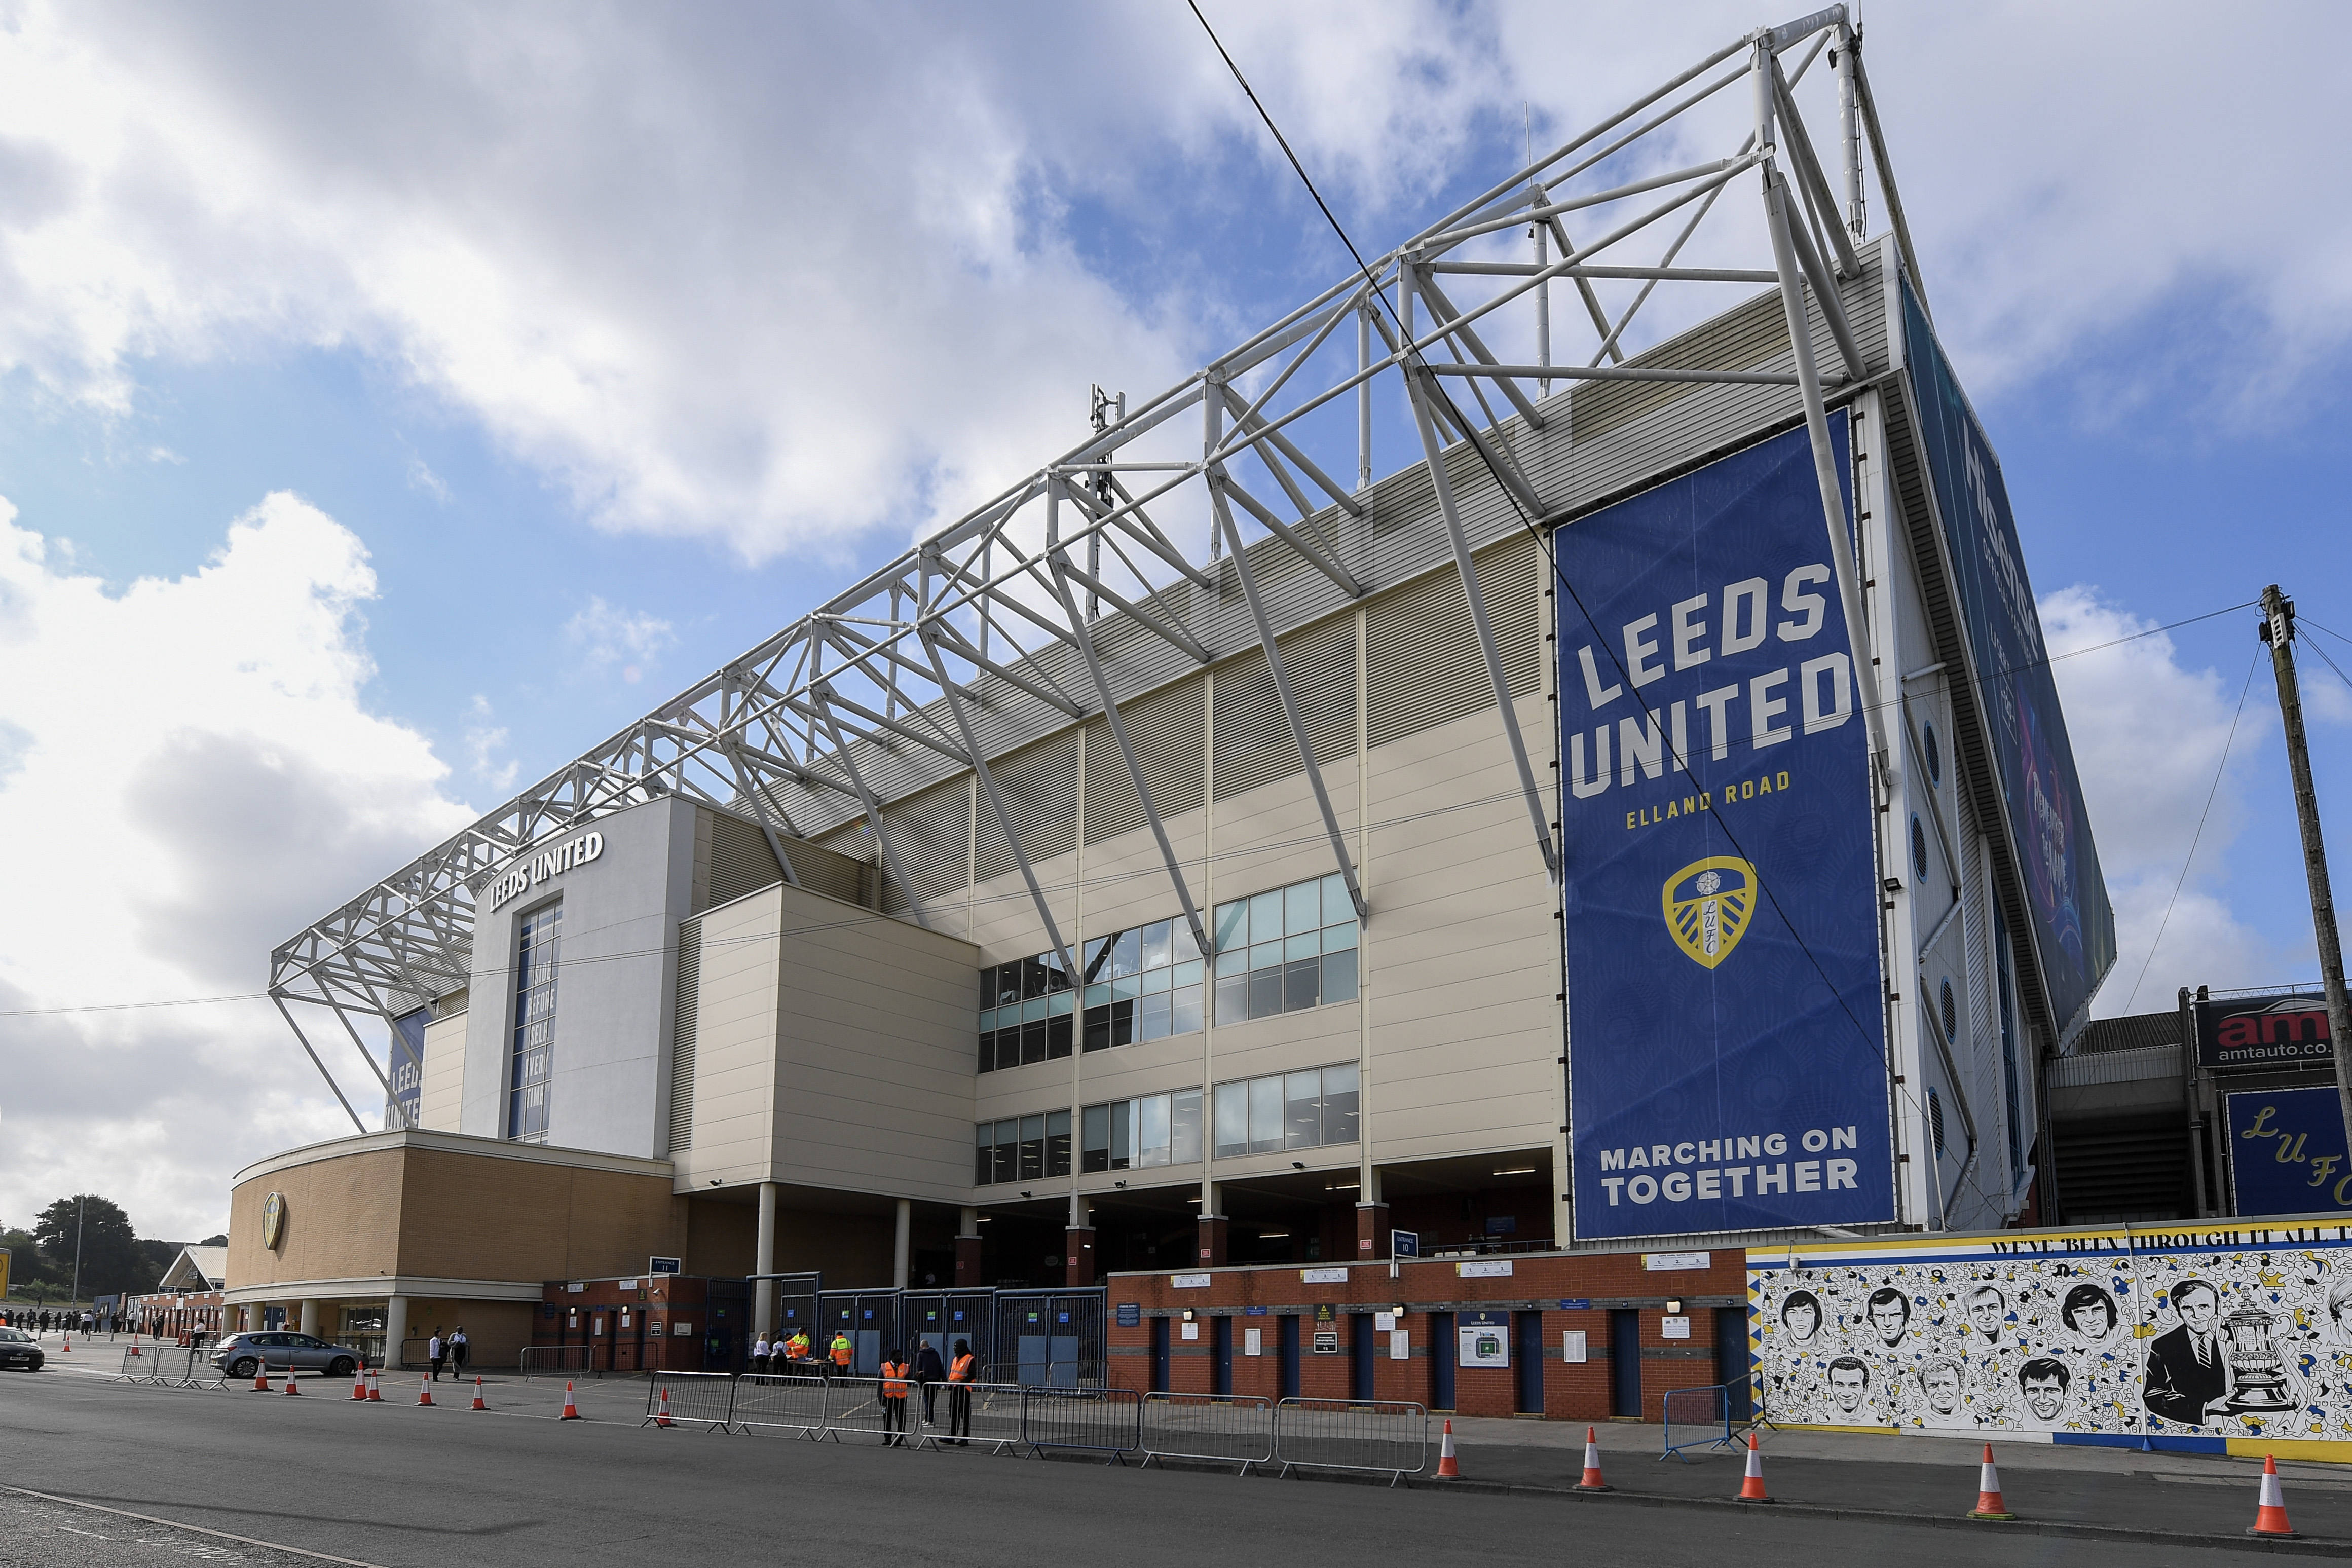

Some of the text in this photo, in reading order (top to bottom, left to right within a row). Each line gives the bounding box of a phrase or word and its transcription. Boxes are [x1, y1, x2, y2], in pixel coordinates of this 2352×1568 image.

[1963, 415, 2039, 661] Hisense
[1983, 537, 2010, 616] OFFICIAL
[1578, 563, 1831, 710] LEEDS
[1571, 651, 1853, 799] UNITED
[1626, 771, 1790, 830] ELLAND ROAD
[490, 831, 605, 913] LEEDS UNITED
[1703, 901, 1716, 953] LUFC
[527, 988, 555, 1017] BEFORE
[392, 1062, 422, 1095] LEED
[1600, 1126, 1857, 1171] MARCHING ON
[1601, 1158, 1858, 1206] TOGETHER
[1402, 1243, 1409, 1252] 10
[1991, 1225, 2352, 1255] WE'VE BEEN THROUGH IT ALL T
